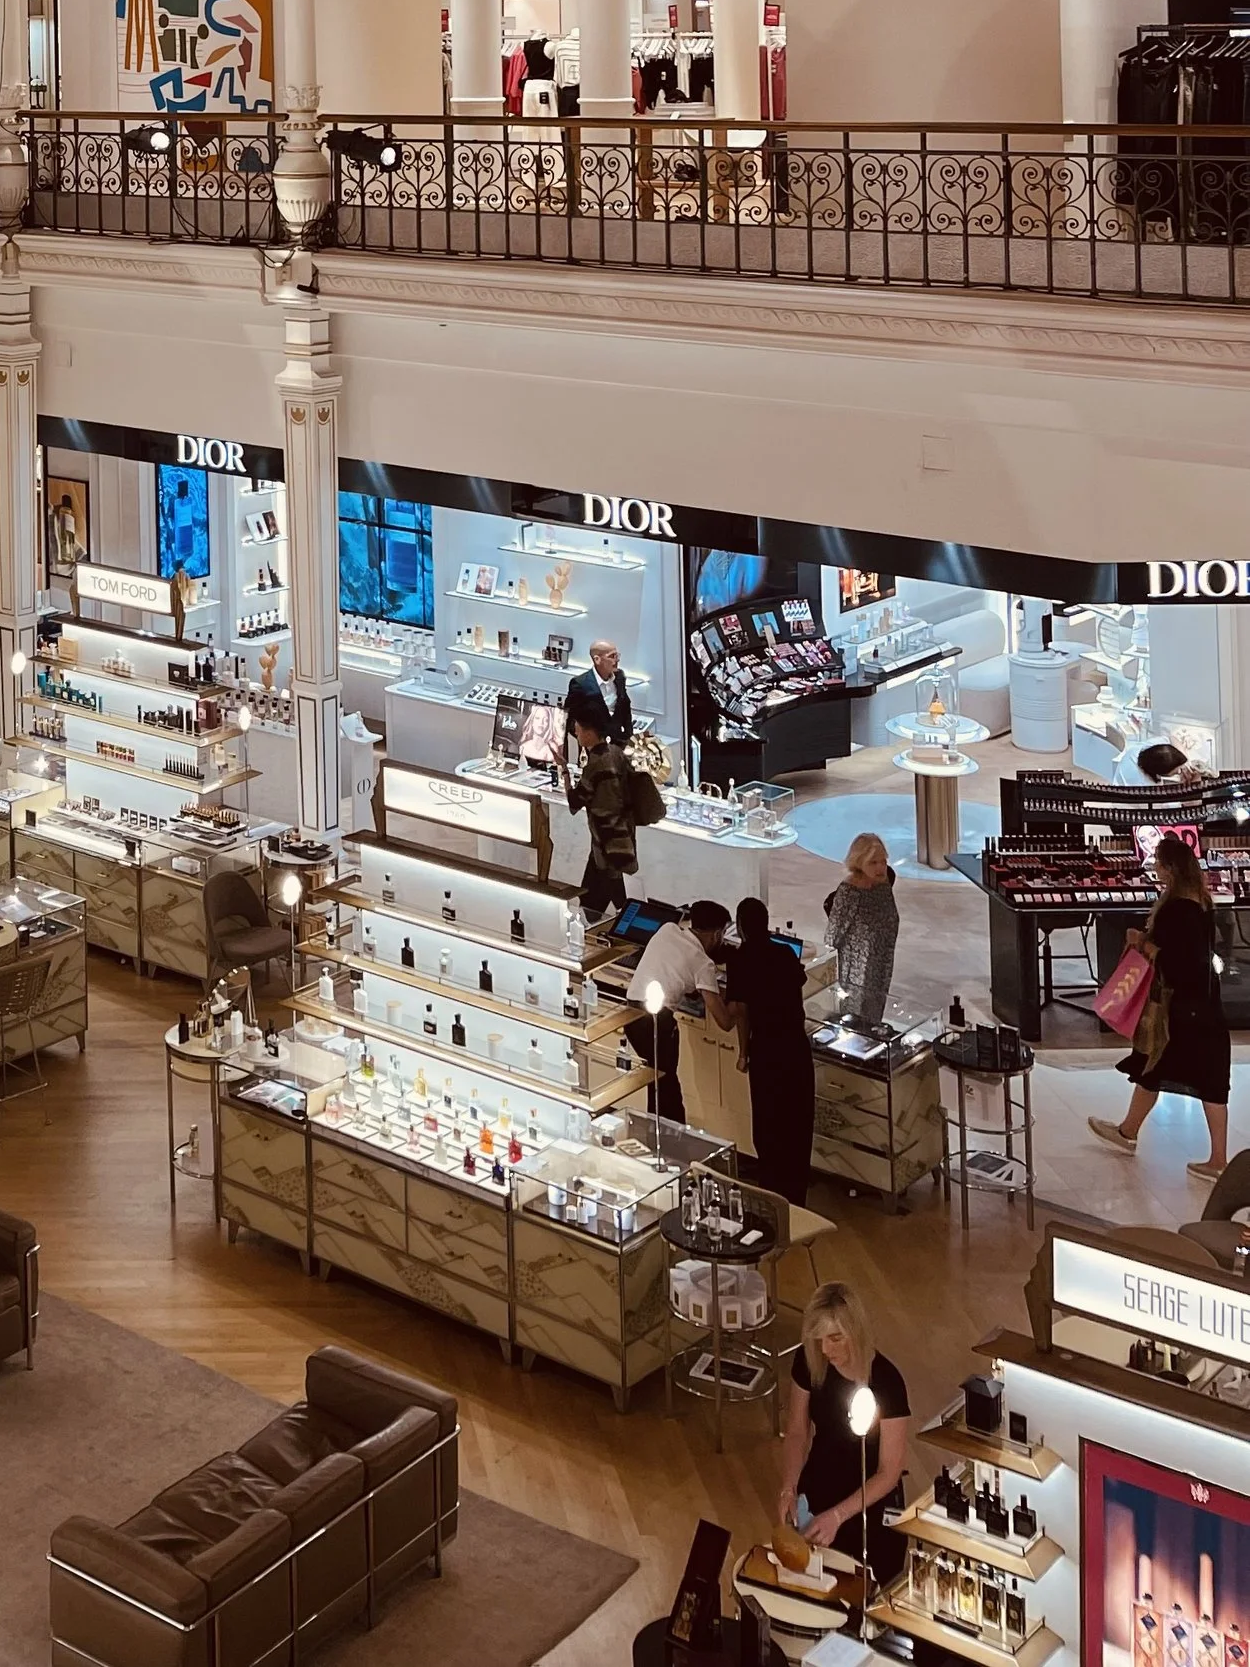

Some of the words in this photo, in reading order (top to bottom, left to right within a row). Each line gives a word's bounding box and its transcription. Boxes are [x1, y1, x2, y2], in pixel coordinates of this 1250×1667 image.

[177, 435, 247, 472] DIOR
[583, 493, 677, 538] DIOR
[91, 575, 118, 595] TOM
[121, 581, 157, 602] FORD
[428, 781, 483, 806] CREED
[1124, 1273, 1188, 1326] SERGE
[1200, 1295, 1250, 1345] LUTE
